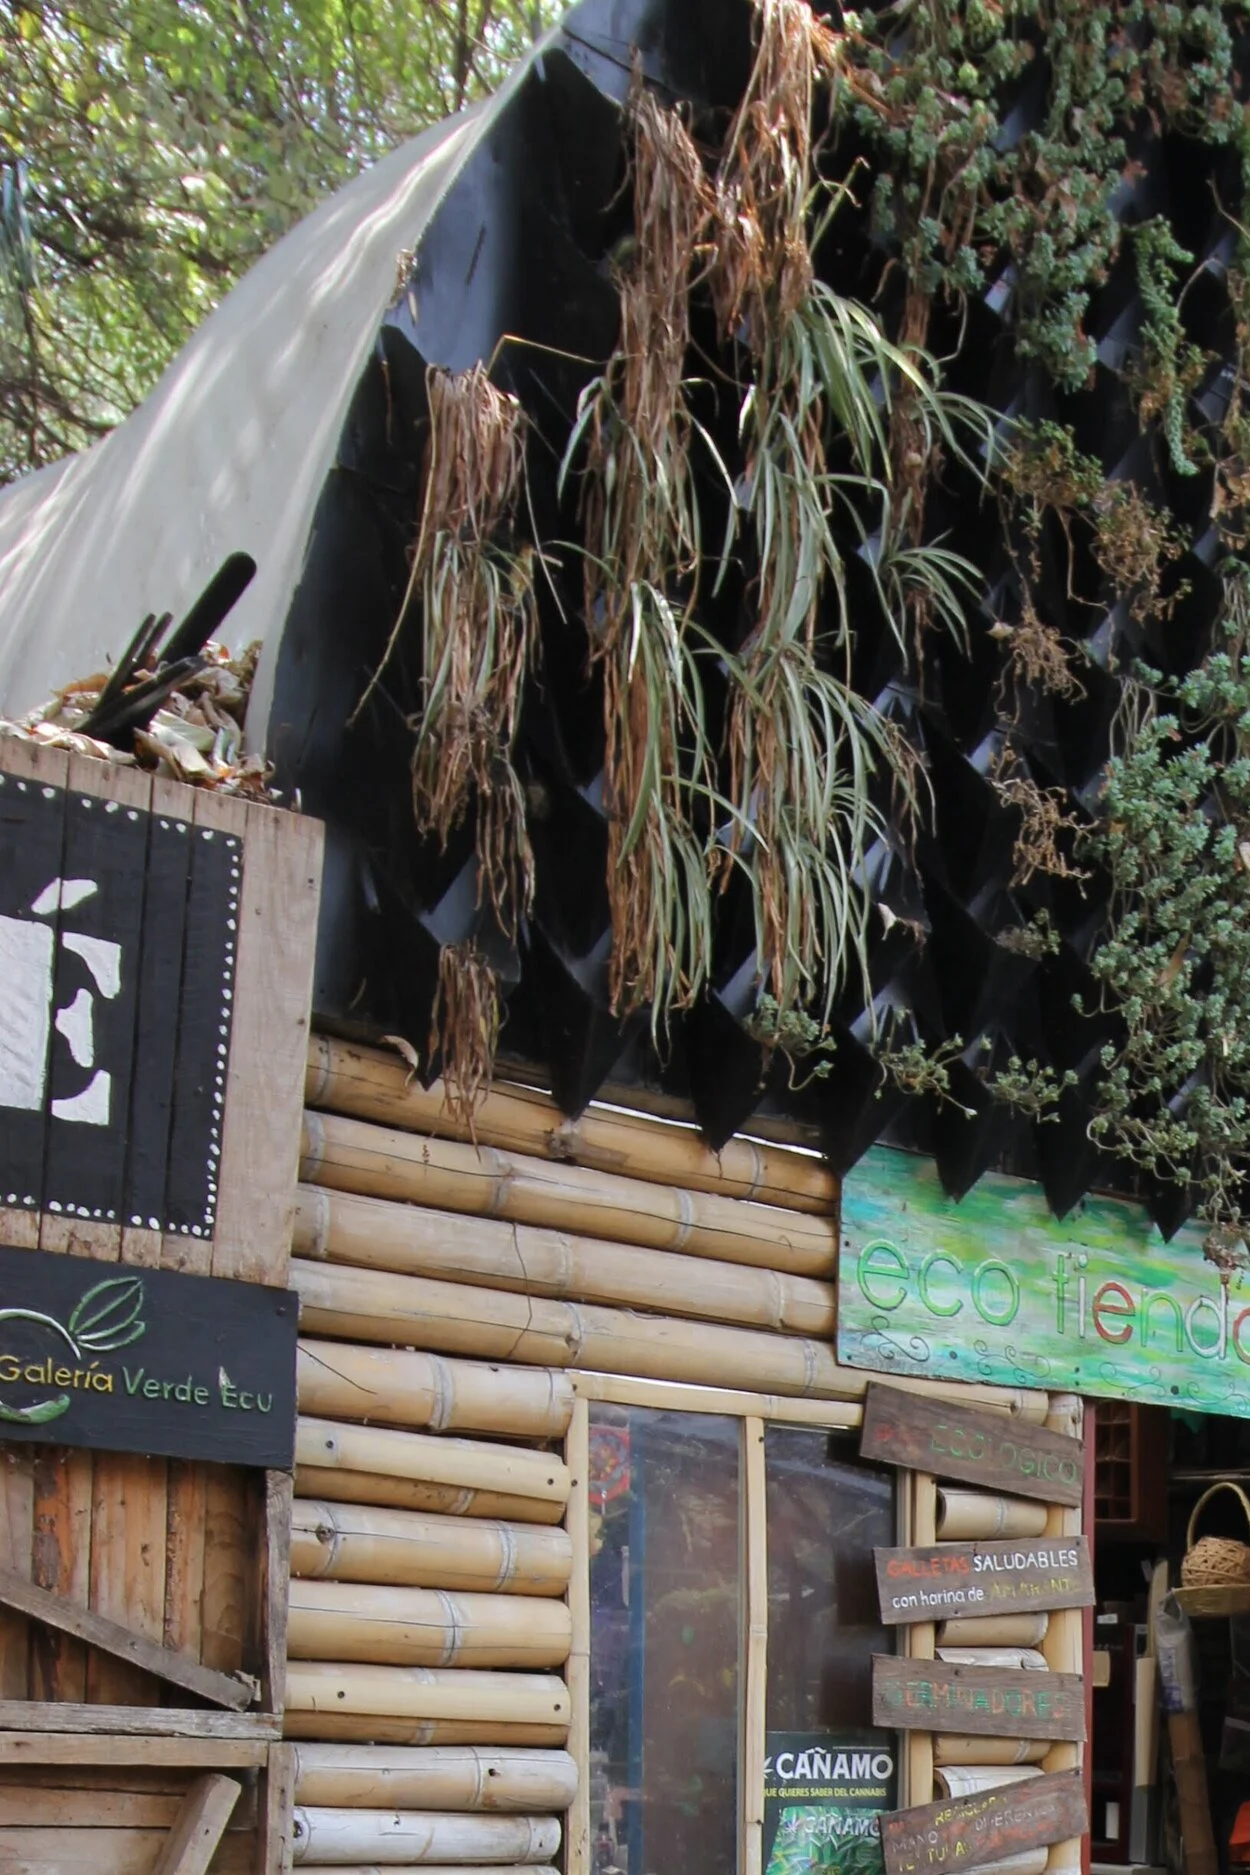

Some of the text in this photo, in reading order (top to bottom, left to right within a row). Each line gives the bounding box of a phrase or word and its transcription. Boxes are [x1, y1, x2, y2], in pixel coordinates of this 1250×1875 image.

[856, 1238, 1020, 1327] eco
[0, 1355, 113, 1393] Galería
[122, 1366, 209, 1405] Verde
[887, 1550, 1078, 1578] GALLETAS SALUDABLES
[892, 1596, 918, 1608] con
[922, 1587, 965, 1605] harina
[969, 1586, 984, 1601] de
[778, 1788, 809, 1798] QUIERES
[810, 1788, 833, 1797] SABER
[834, 1788, 848, 1798] DEL
[849, 1788, 887, 1797] CANNABIS
